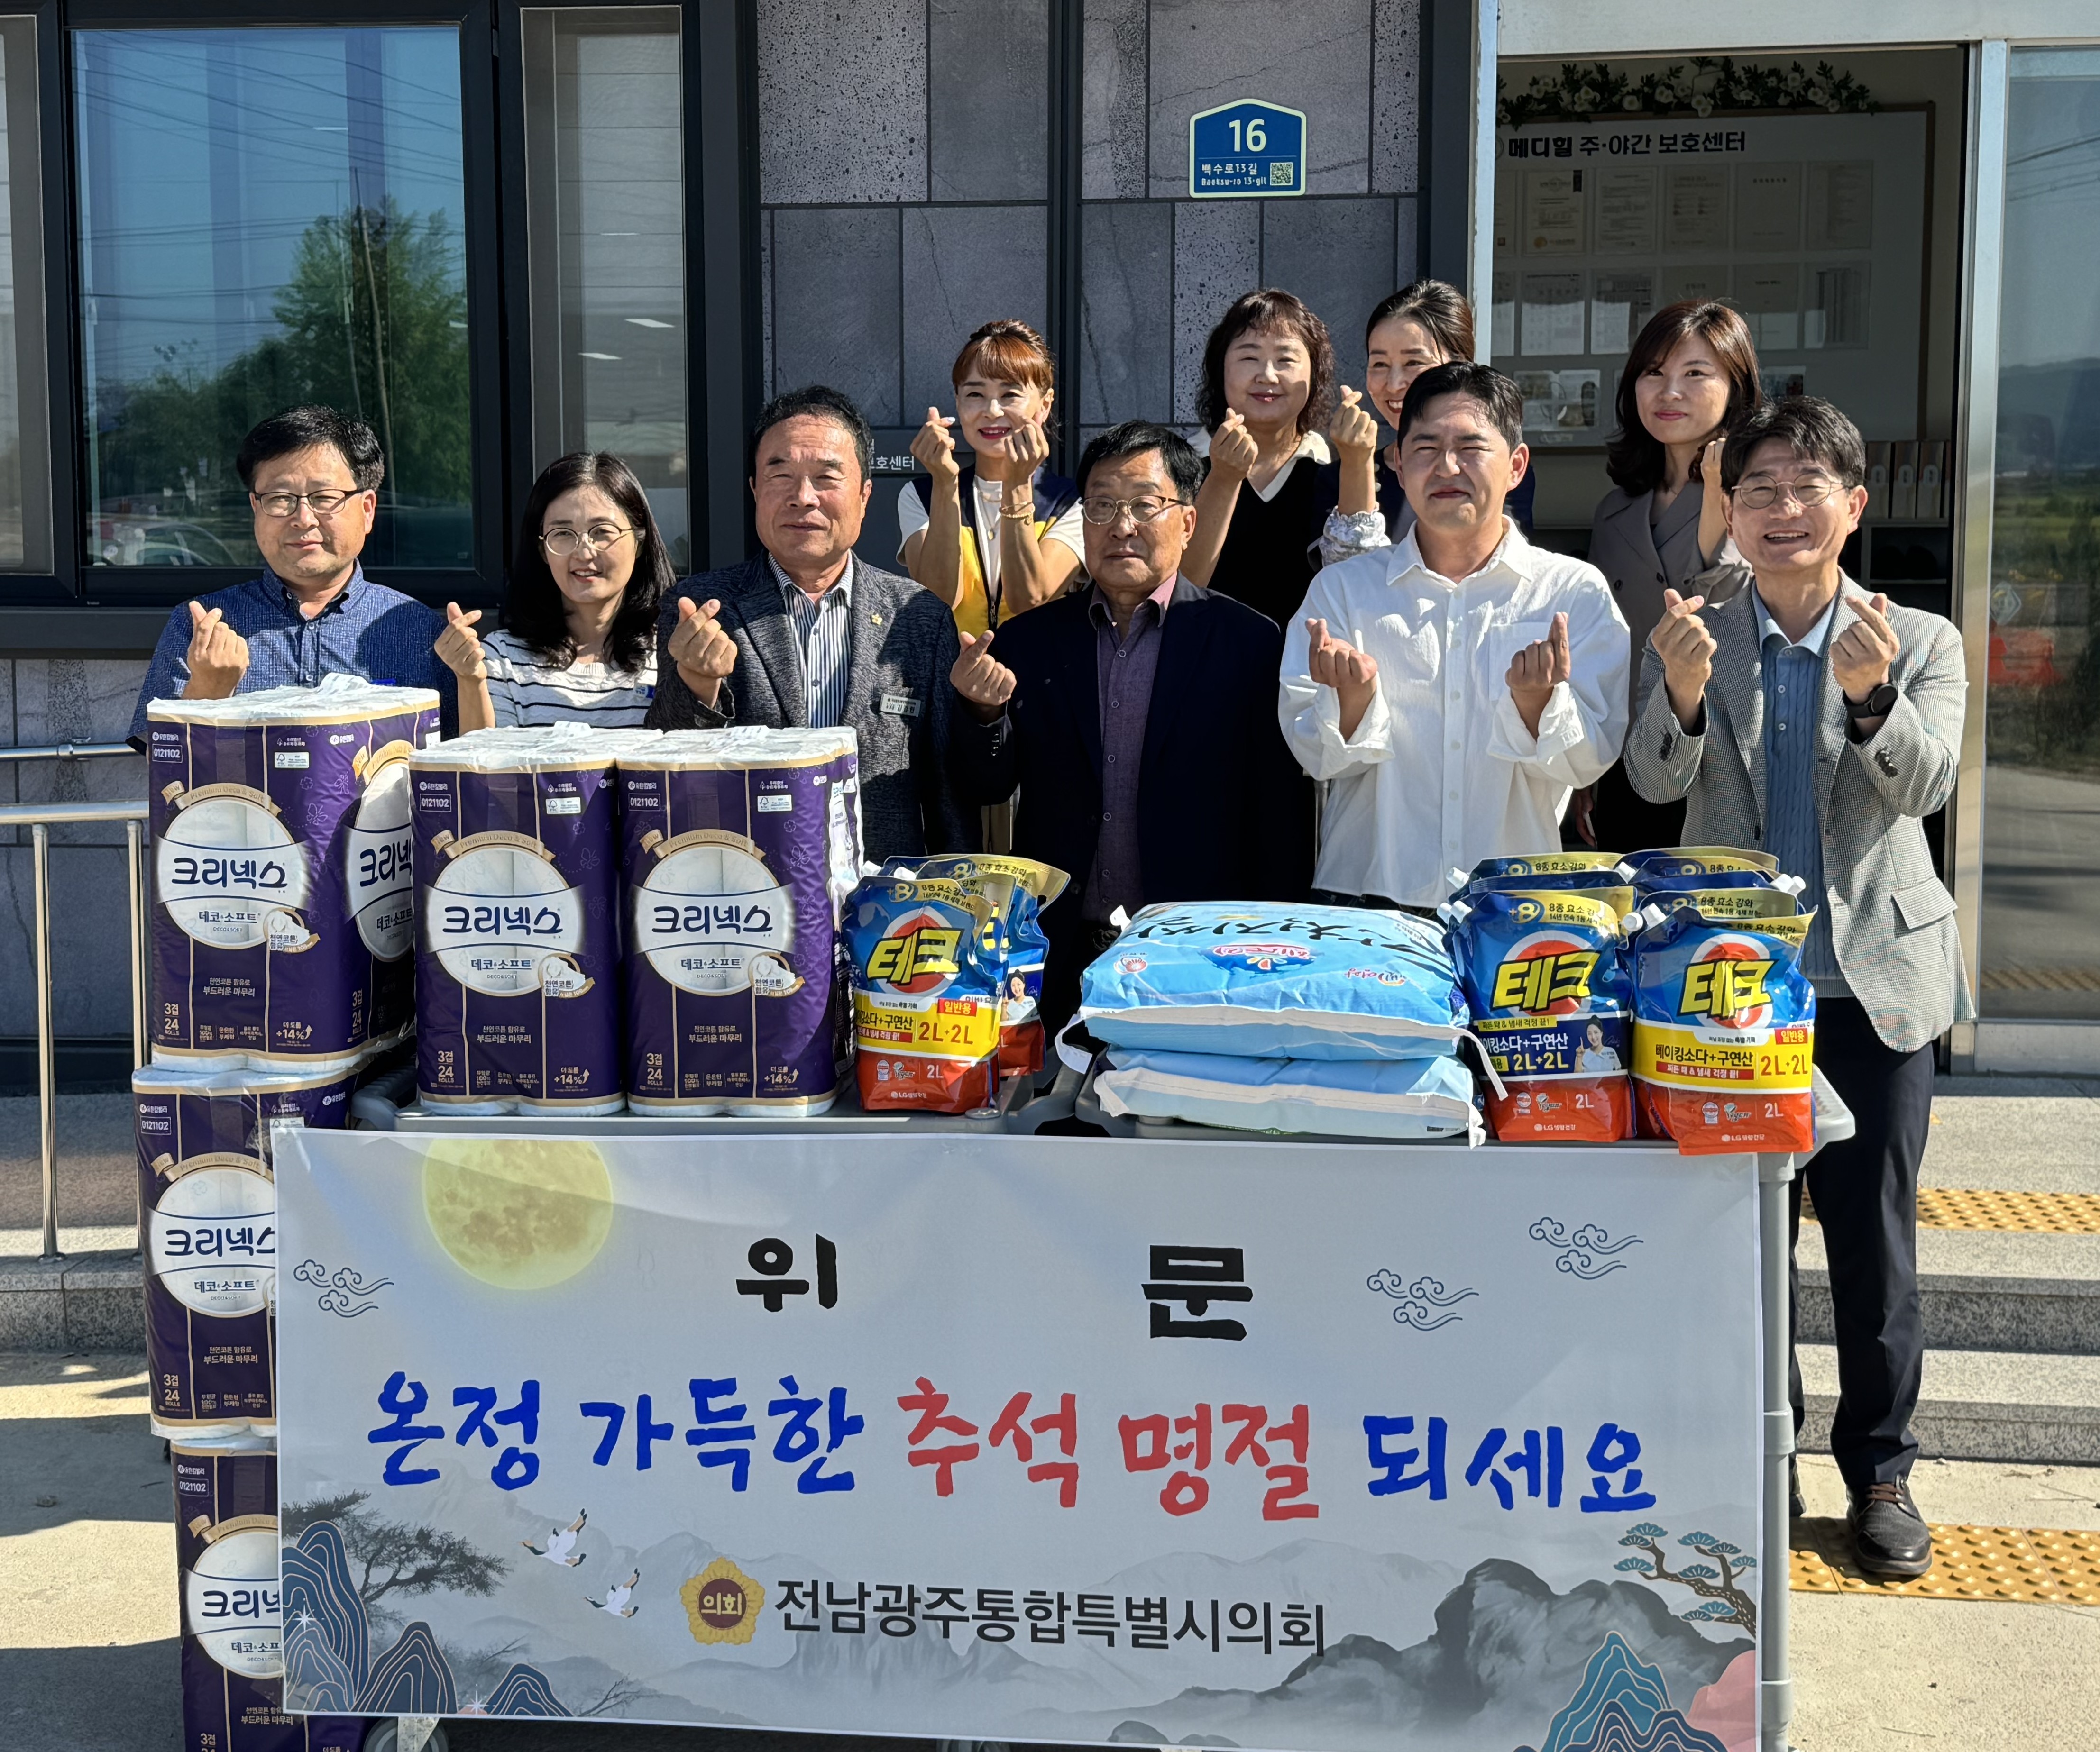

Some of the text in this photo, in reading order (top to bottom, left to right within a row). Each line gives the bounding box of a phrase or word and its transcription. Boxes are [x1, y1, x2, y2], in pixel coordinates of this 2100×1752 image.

[1229, 119, 1266, 152] 16
[1508, 131, 1745, 158] 메디힐 주·야간 보호센터
[1202, 163, 1257, 176] 백수로13길
[154, 748, 181, 759] 0121102
[421, 798, 449, 808] 0121102
[630, 797, 659, 807] 0121102
[360, 838, 413, 887] 크리넥
[1535, 862, 1550, 871] 8종
[1551, 862, 1568, 871] 효소
[171, 857, 287, 889] 크리넥스
[1549, 903, 1585, 914] 8종 효소
[1701, 897, 1754, 908] 8종 효소 강화
[442, 906, 563, 936] 크리넥스
[652, 905, 773, 934] 크리넥스
[867, 927, 965, 986] 테크
[1490, 949, 1603, 1013] 테크
[203, 986, 255, 997] 부드러운 마무리
[1677, 959, 1780, 1020] 테크
[164, 1003, 179, 1015] 3겹
[944, 1001, 972, 1015] 일반용
[165, 1018, 179, 1031] 24
[352, 1009, 362, 1027] 24
[1501, 1020, 1507, 1028] &
[1509, 1018, 1522, 1028] 냄새
[1524, 1018, 1538, 1027] 걱정
[1539, 1017, 1550, 1027] 끝!
[276, 1028, 304, 1040] +14%
[477, 1034, 531, 1044] 부드러운 마무리
[689, 1034, 742, 1043] 부드러운 마무리
[919, 1021, 973, 1045] 2L+2L
[1780, 1030, 1805, 1043] 일반용
[437, 1050, 454, 1063] 3겹
[647, 1053, 663, 1066] 3겹
[1513, 1051, 1569, 1071] 2L+2L
[1656, 1044, 1753, 1067] 베이킹소다+구연산
[927, 1064, 944, 1079] 2L
[1761, 1053, 1808, 1077] 2L+2L
[438, 1066, 454, 1078] 24
[647, 1068, 663, 1080] 24
[764, 1073, 792, 1084] +14%
[1689, 1066, 1695, 1075] &
[1713, 1068, 1727, 1078] 걱정
[554, 1074, 584, 1085] +14%
[1575, 1093, 1595, 1109] 2L
[1764, 1102, 1785, 1118] 2L
[141, 1120, 169, 1131] 0121102
[165, 1227, 275, 1257] 크리넥스
[203, 1354, 258, 1364] 부드러운 마무리
[164, 1373, 179, 1387] 3겹
[165, 1389, 180, 1402] 24
[368, 1371, 1657, 1521] 온정 가득한 추석 명절 되세요
[179, 1481, 206, 1492] 0121102
[701, 1592, 743, 1617] 의회
[774, 1579, 1326, 1657] 전남광주통합특별시의회
[241, 1715, 293, 1725] 부드러운 마무리
[200, 1733, 216, 1745] 3겹
